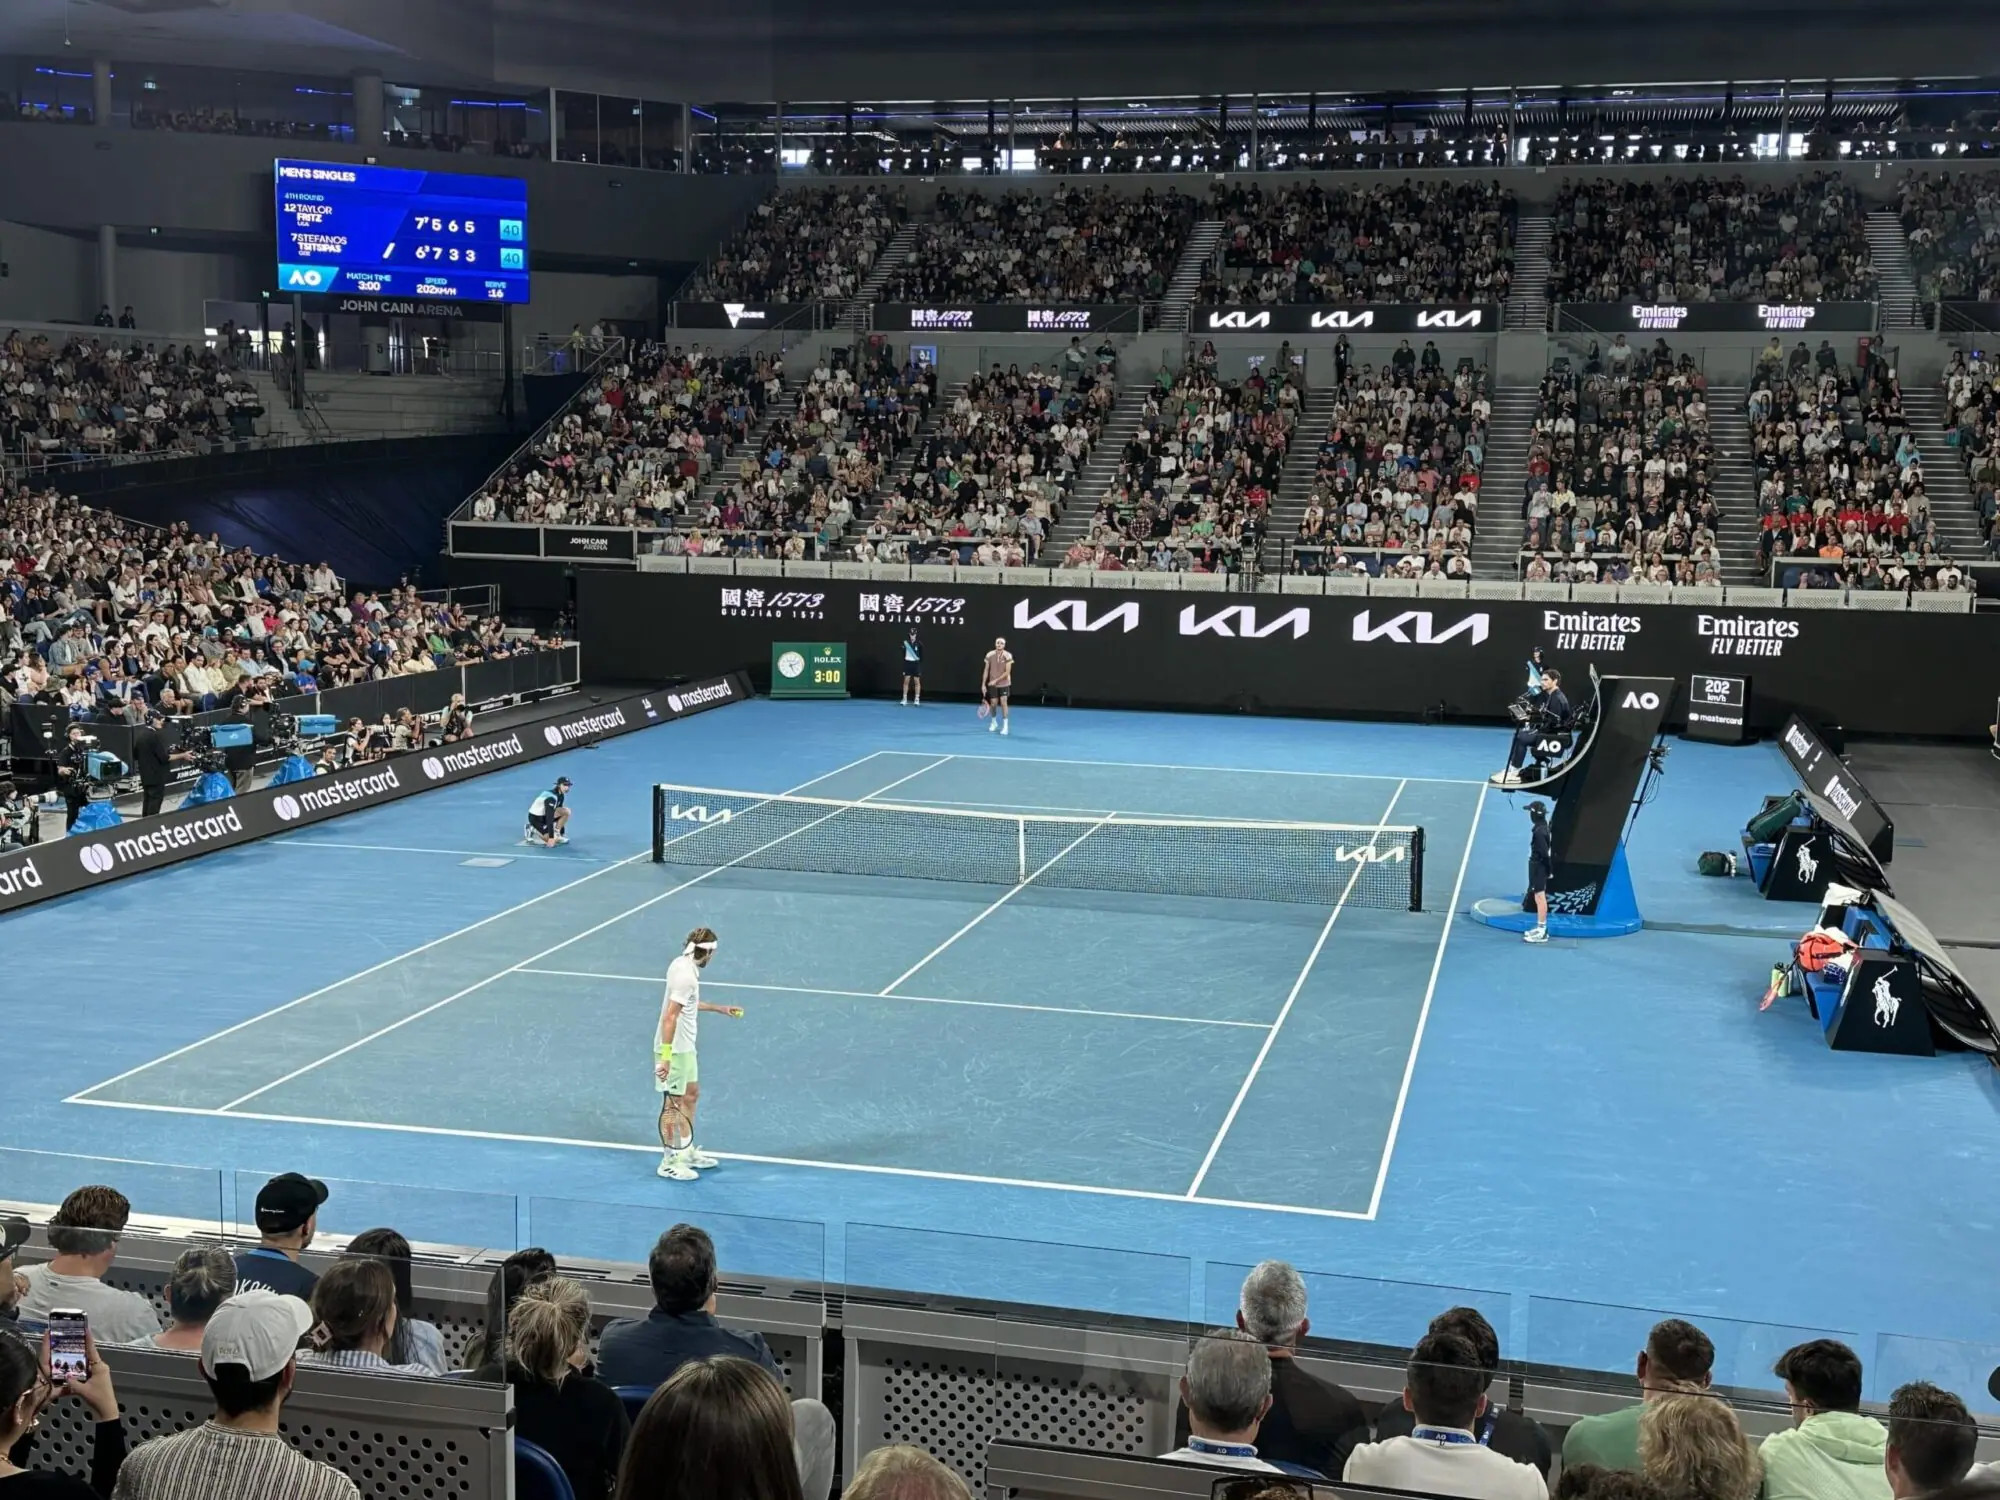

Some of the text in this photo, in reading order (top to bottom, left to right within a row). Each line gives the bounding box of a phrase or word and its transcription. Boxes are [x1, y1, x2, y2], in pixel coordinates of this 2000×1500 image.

[280, 167, 356, 182] MEN'S SINGLES
[299, 193, 325, 201] ROUND
[284, 203, 333, 215] 12 TAYLOR
[297, 213, 323, 223] FRITZ
[432, 218, 442, 231] 5
[448, 220, 459, 232] 6
[465, 221, 475, 233] 5
[503, 225, 519, 236] 40
[290, 233, 348, 245] 7 STEFANOS
[297, 242, 342, 254] TSITSIPAS
[432, 247, 443, 260] 7
[449, 248, 459, 261] 3
[465, 249, 476, 262] 3
[504, 253, 520, 264] 40
[289, 270, 321, 286] AO
[346, 272, 392, 282] MATCH TIME
[425, 277, 447, 285] SPEED
[358, 281, 381, 291] 3:00
[340, 300, 463, 316] JOHN CAIN ARENA
[1632, 304, 1688, 318] Emirates
[1758, 304, 1815, 318] Emirates
[1209, 311, 1270, 328] KIA
[1311, 310, 1374, 328] KIA
[1417, 310, 1481, 328] KIA
[569, 537, 591, 545] JOHN
[721, 608, 824, 619] GUOJIAO 1573
[859, 613, 964, 625] GUOJIAO 1573
[1014, 598, 1139, 633] KIA
[1544, 610, 1641, 633] Emirates
[1179, 604, 1310, 640] KIA
[1352, 609, 1490, 646] KIA
[1698, 615, 1799, 638] Emirates
[1557, 633, 1626, 651] FLY BETTER
[1711, 638, 1783, 656] FLY BETTER
[814, 656, 842, 664] ROLEX
[814, 670, 840, 683] 3:00
[680, 678, 732, 708] mastercard
[1705, 680, 1730, 694] 202
[1622, 691, 1660, 710] AO
[560, 706, 626, 741] mastercard
[1700, 714, 1743, 726] mastercard
[444, 733, 523, 773] mastercard
[1537, 739, 1562, 753] AO
[299, 765, 400, 812] mastercard
[671, 803, 731, 824] KIA
[114, 805, 242, 862] mastercard
[1336, 844, 1404, 863] KIA
